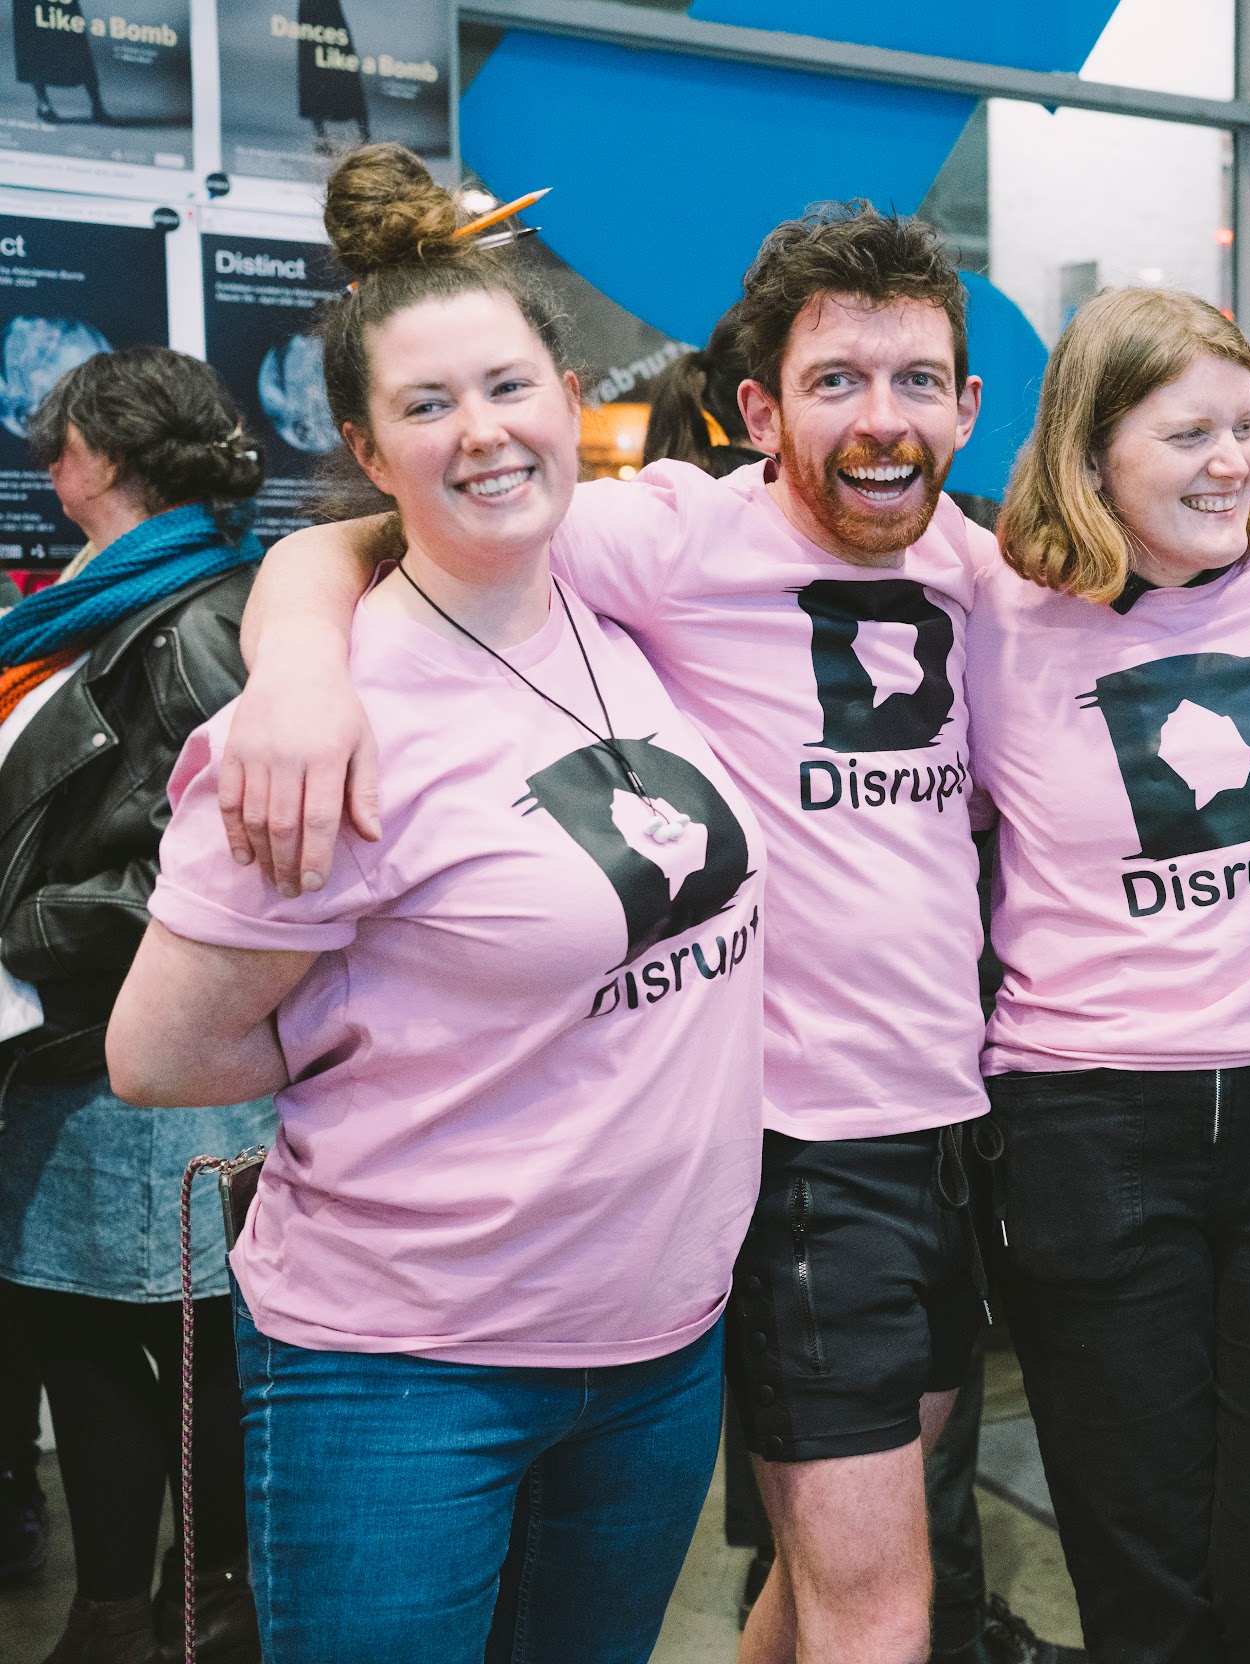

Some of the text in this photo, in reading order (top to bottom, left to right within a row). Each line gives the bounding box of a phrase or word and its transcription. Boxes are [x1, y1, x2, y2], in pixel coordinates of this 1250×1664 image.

[35, 4, 178, 48] Like a Bomb
[270, 14, 349, 46] Dances
[315, 45, 438, 83] Like a Bomb
[0, 234, 26, 258] ct
[215, 249, 307, 280] Distinct
